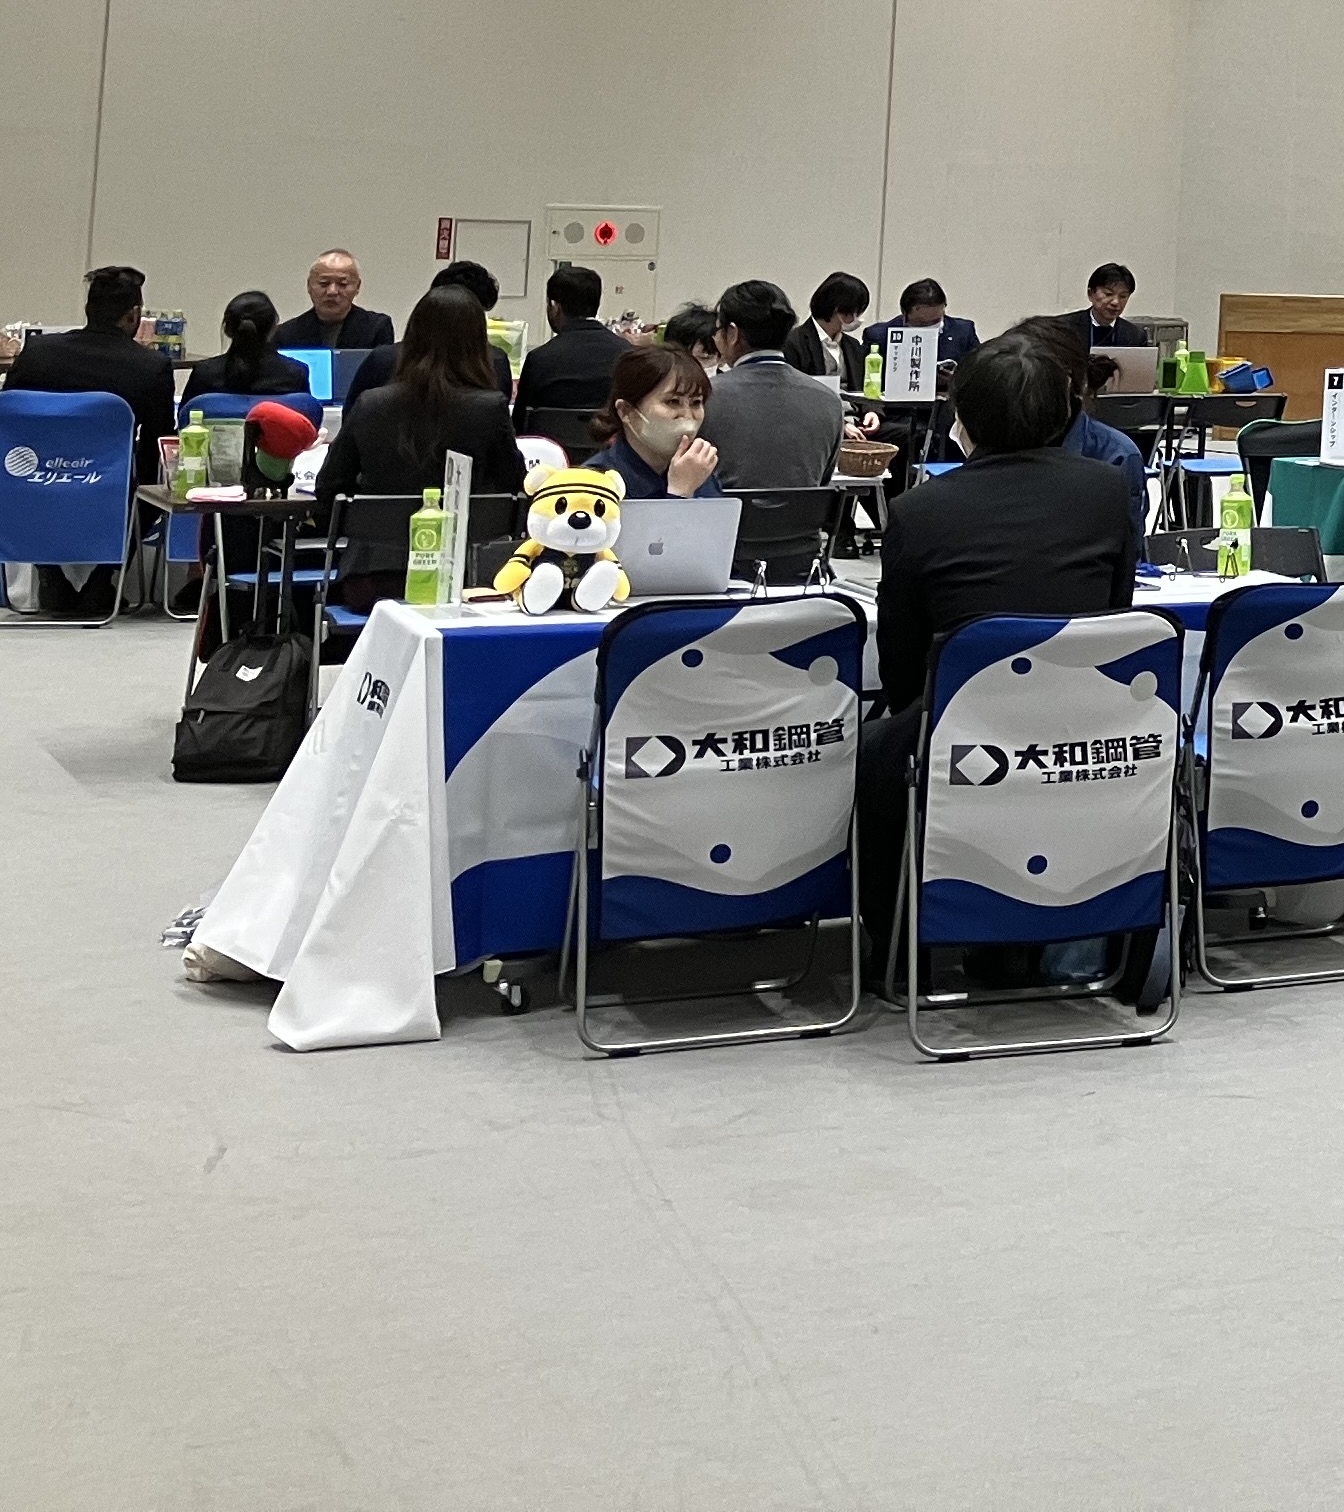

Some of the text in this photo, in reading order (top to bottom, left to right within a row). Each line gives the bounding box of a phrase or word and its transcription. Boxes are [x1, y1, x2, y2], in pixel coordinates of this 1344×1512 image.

[45, 457, 95, 468] elleair
[26, 471, 102, 486] エリエール
[691, 717, 845, 760] 大和鋼管
[719, 749, 822, 772] 工業株式会社
[1014, 733, 1163, 770] 大和鋼管
[1040, 763, 1138, 785] 工業株式会社
